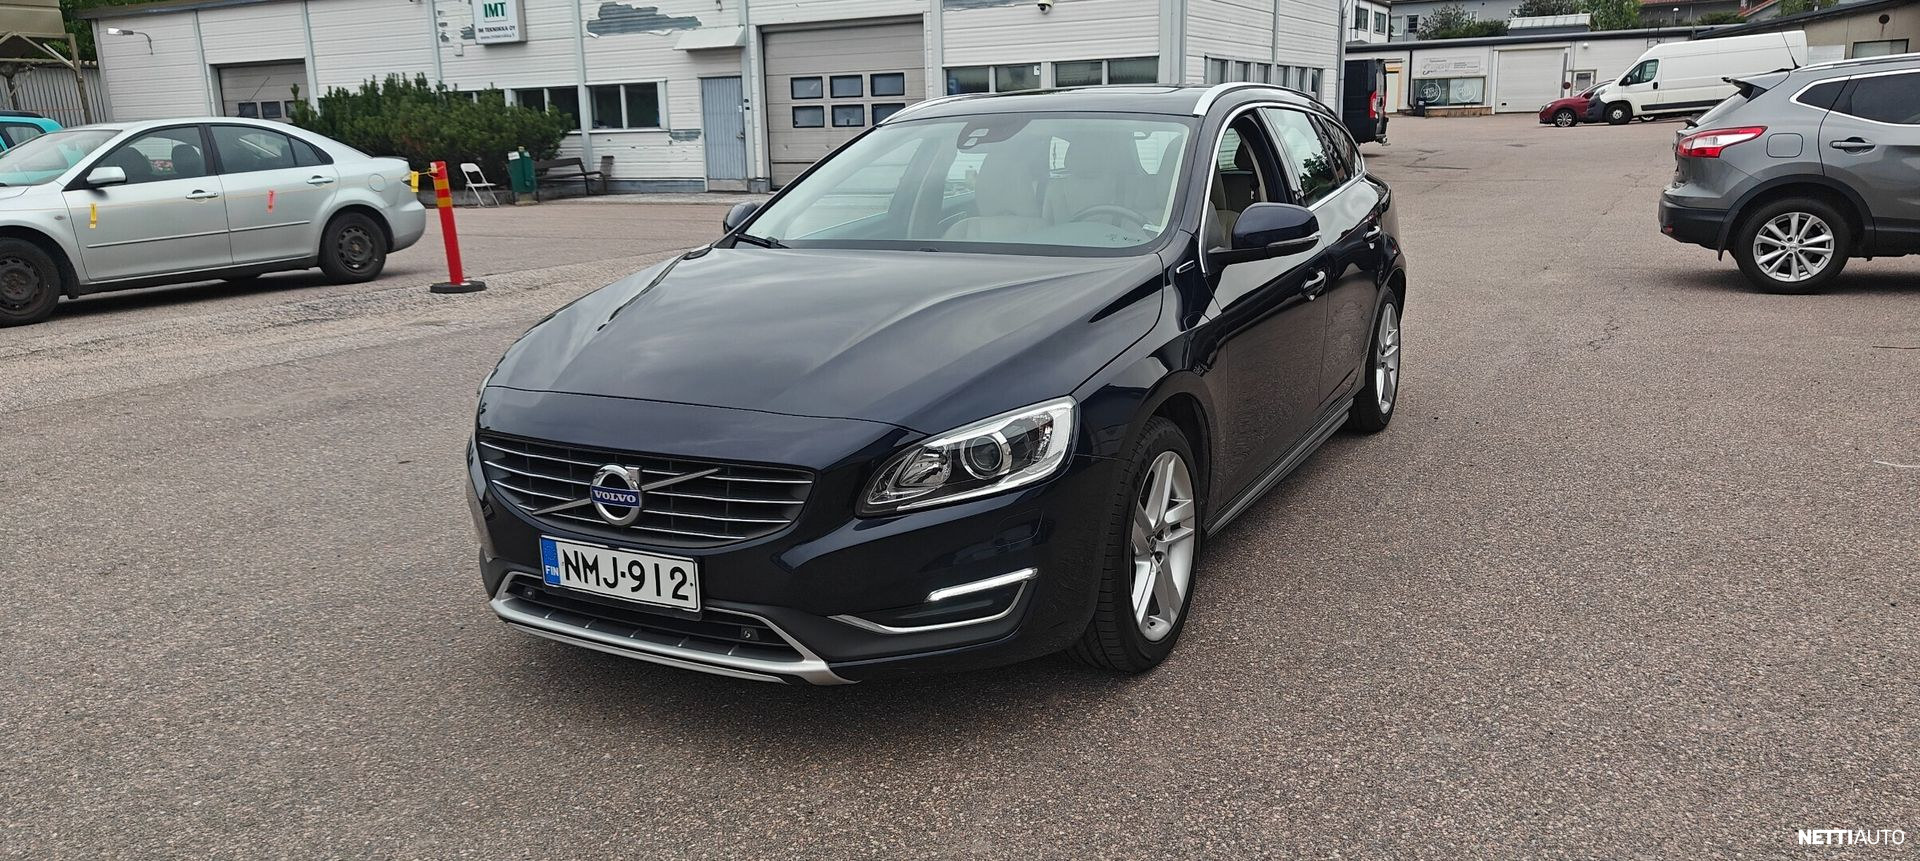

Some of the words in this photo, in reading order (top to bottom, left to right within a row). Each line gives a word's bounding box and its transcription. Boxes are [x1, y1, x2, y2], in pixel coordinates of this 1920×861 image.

[484, 2, 506, 17] IMT
[593, 490, 637, 503] VOLVO
[545, 564, 560, 577] FIN
[562, 548, 689, 601] NMJ-912
